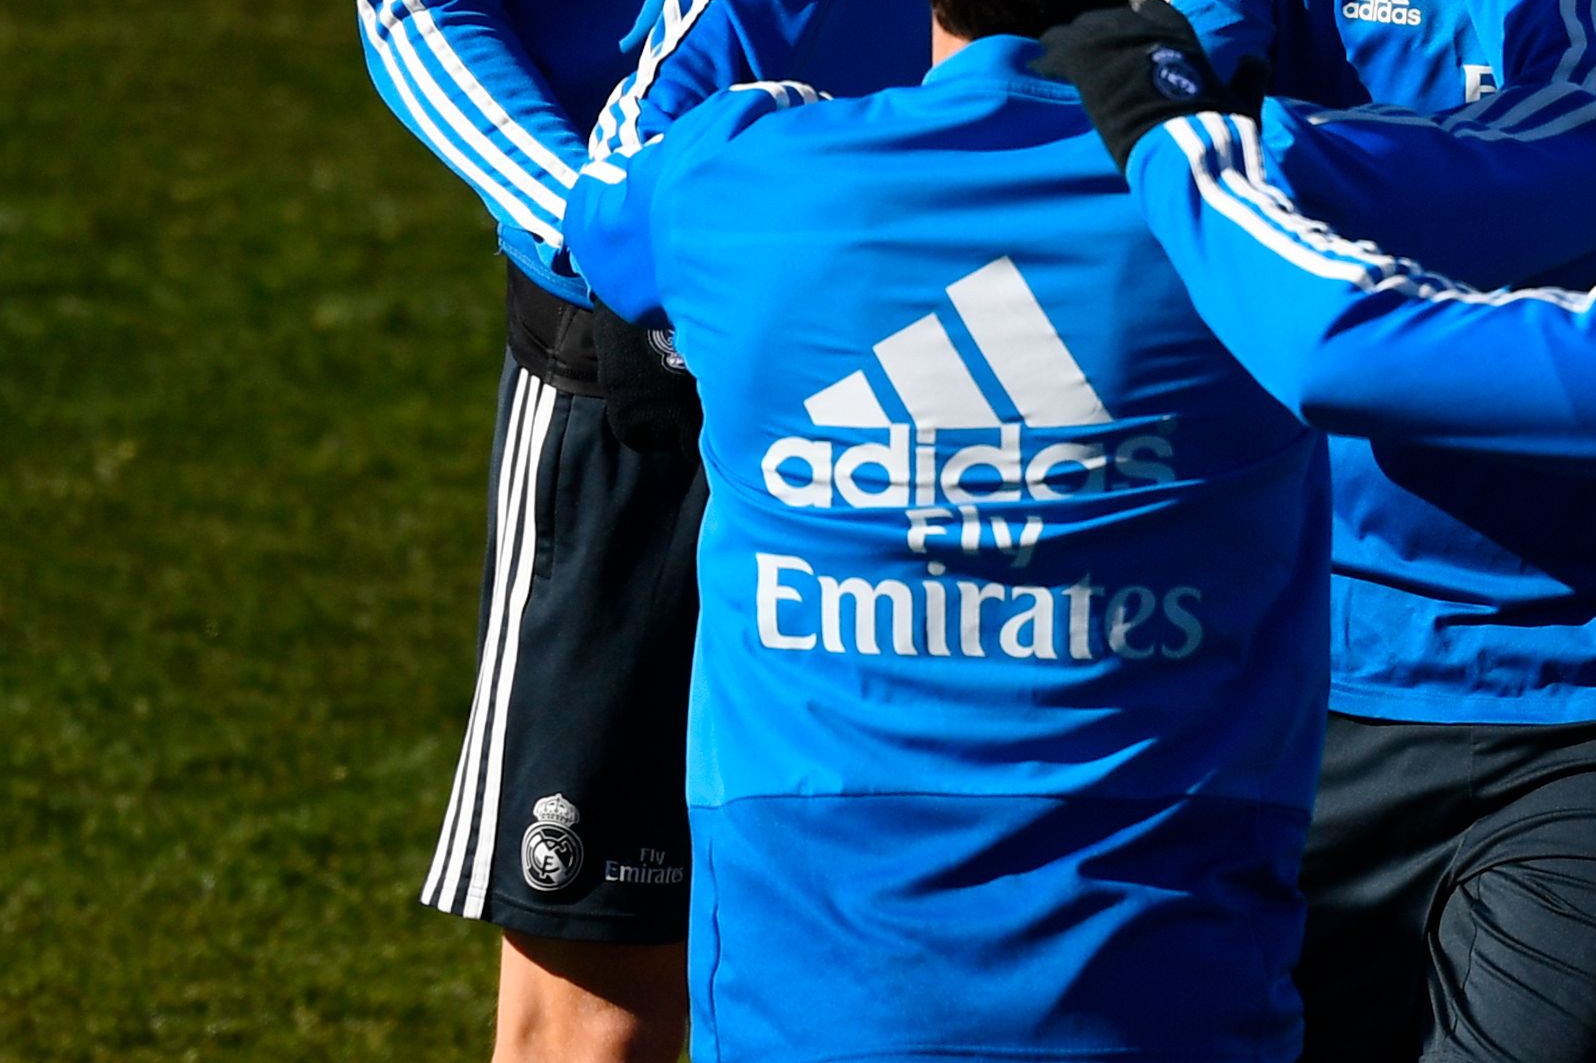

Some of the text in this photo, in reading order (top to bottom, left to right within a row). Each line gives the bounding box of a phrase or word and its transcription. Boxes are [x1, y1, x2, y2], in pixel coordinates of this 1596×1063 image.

[1343, 0, 1421, 25] adidas
[761, 423, 1177, 509] adidas
[905, 505, 1044, 568] Fly
[756, 552, 1202, 660] Emirates
[640, 848, 666, 865] Fly
